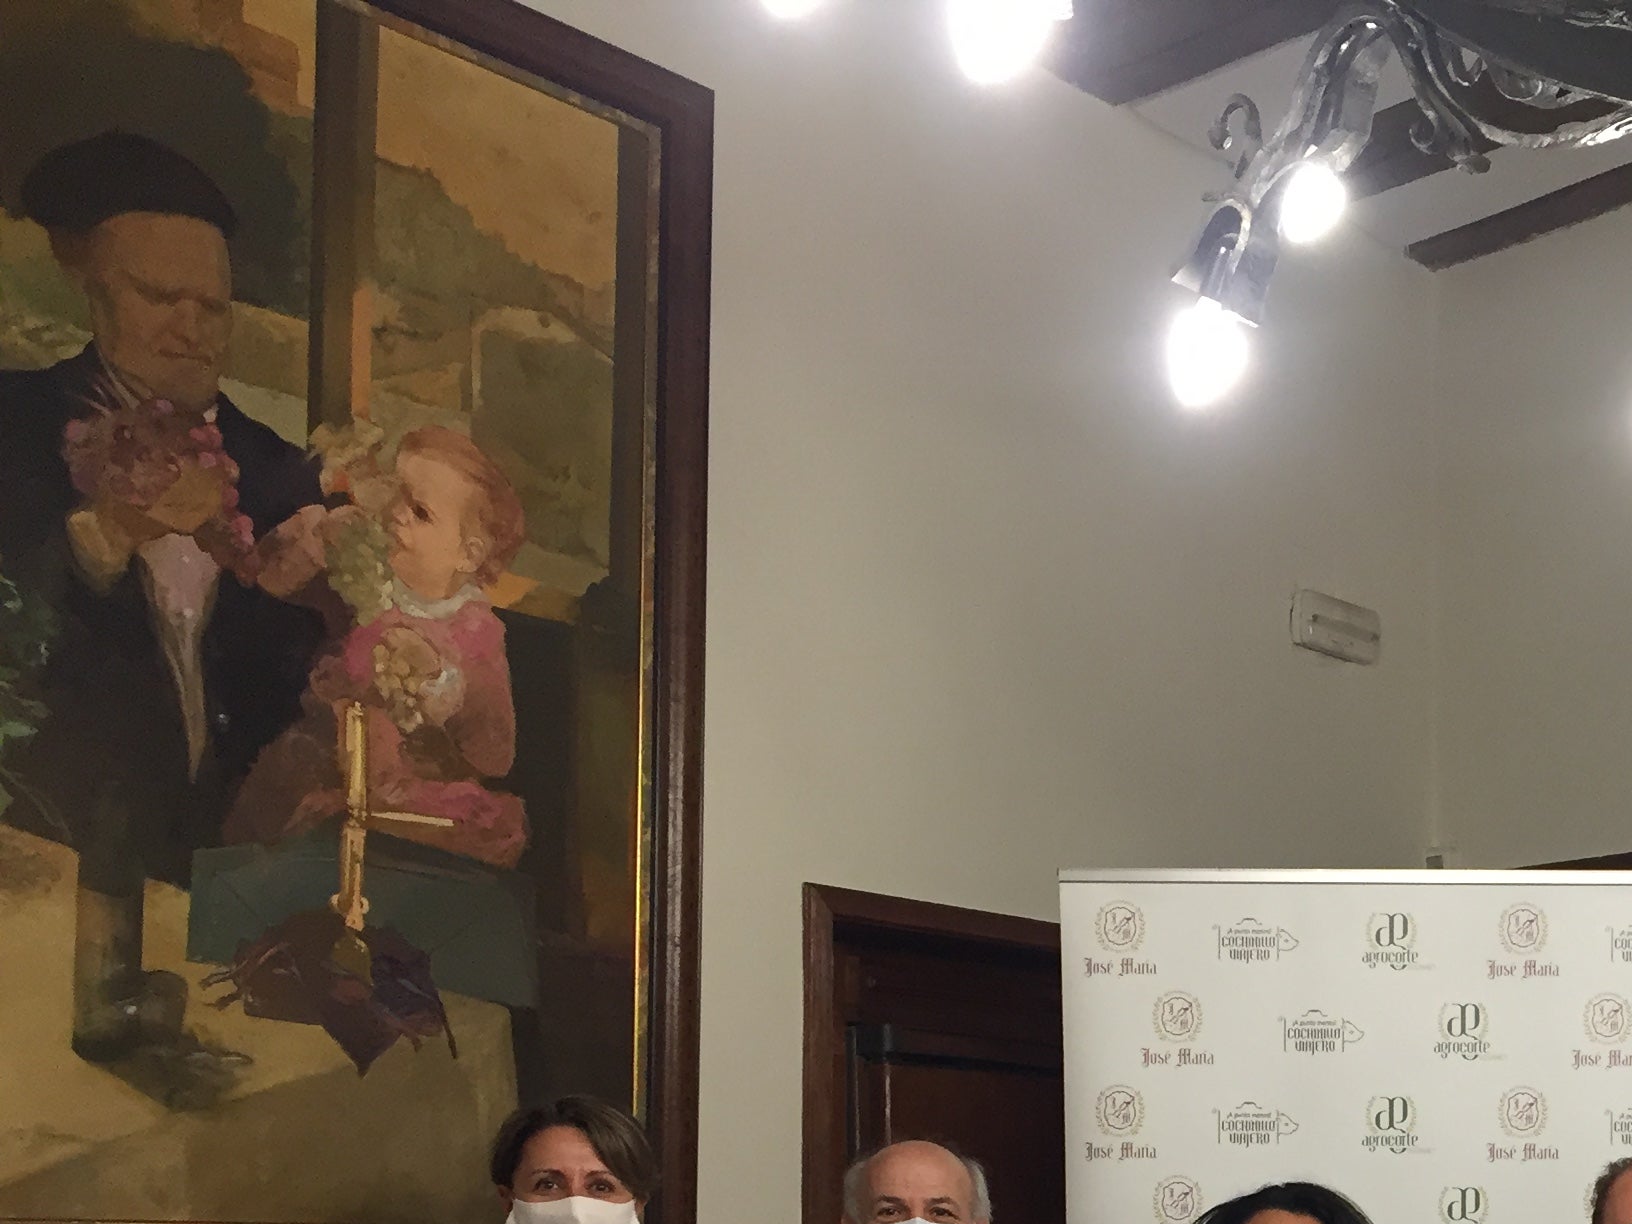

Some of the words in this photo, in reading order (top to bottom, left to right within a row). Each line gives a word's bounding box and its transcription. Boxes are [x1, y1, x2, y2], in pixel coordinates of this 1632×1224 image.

[1229, 948, 1271, 963] VIAJERO
[1361, 950, 1419, 969] agrocorte
[1295, 1039, 1336, 1055] VIAJERO
[1433, 1040, 1491, 1059] agrocorte
[1229, 1131, 1270, 1147] VIAJERO
[1361, 1133, 1419, 1152] agrocorte
